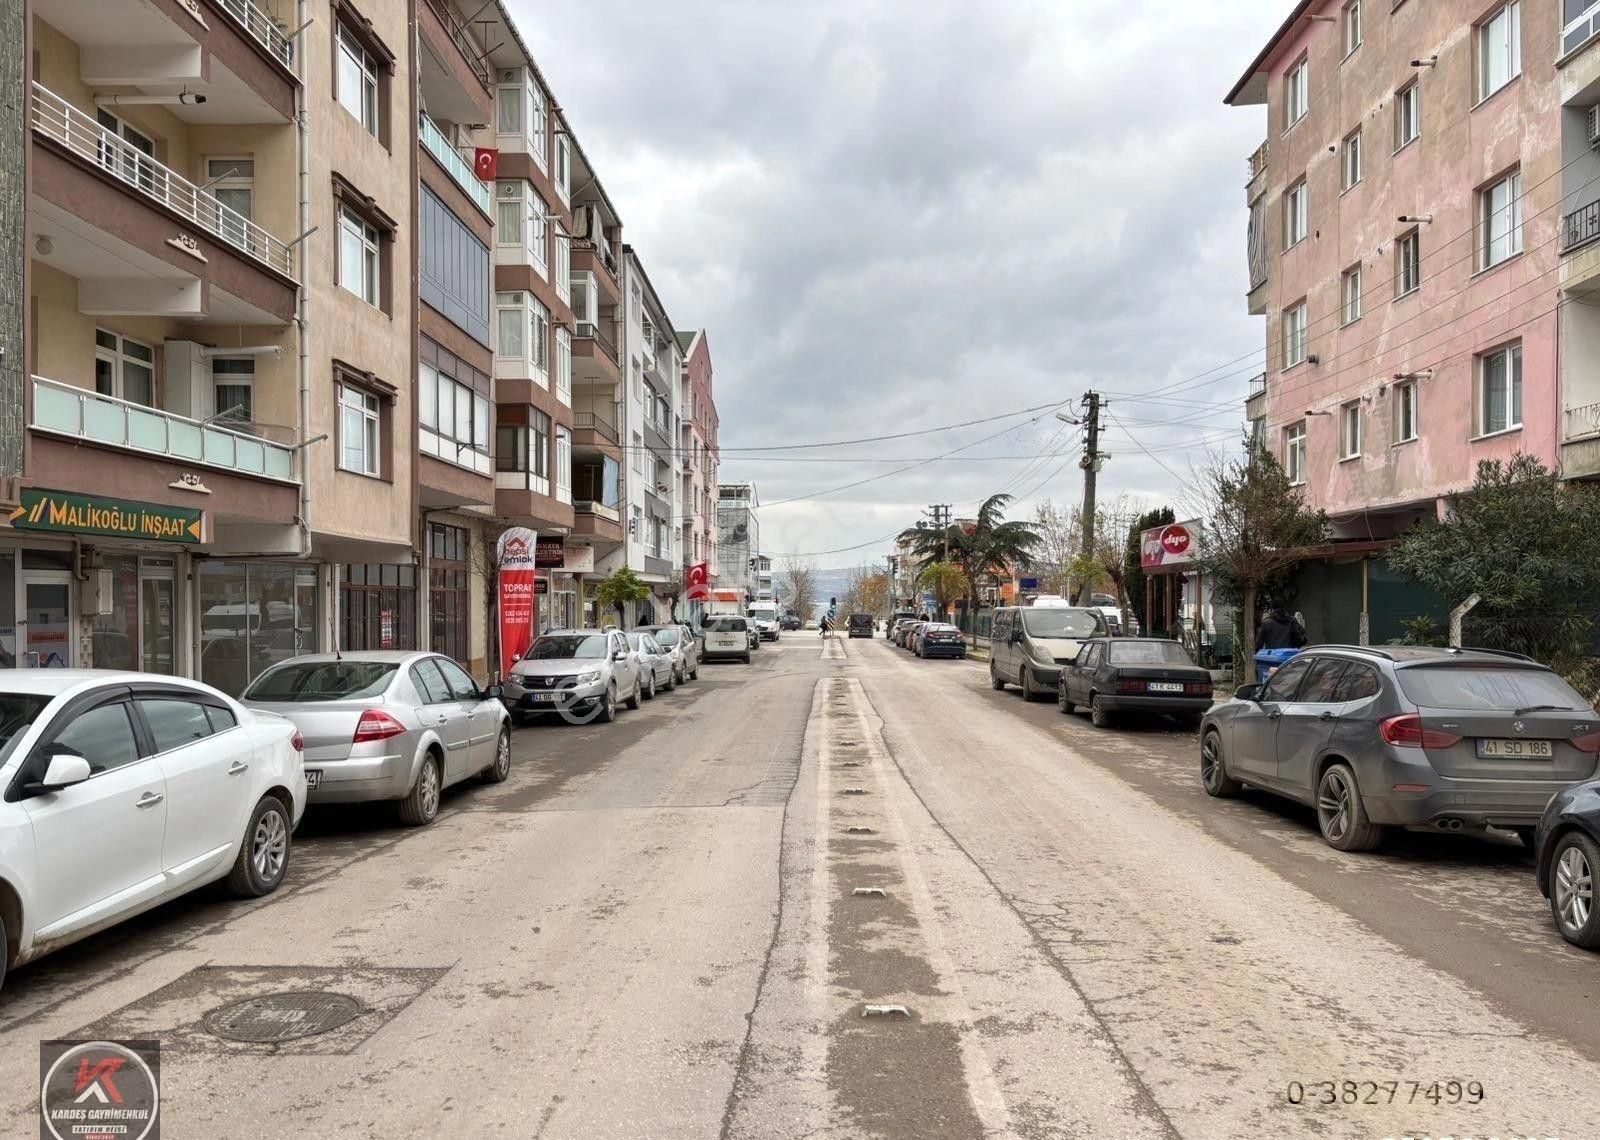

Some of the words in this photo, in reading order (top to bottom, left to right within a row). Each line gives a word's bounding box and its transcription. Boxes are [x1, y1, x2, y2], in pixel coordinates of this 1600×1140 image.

[49, 499, 137, 531] MALİKOĞLU
[141, 510, 186, 538] İNŞAAT
[1164, 534, 1187, 546] dyo
[1485, 741, 1497, 753] 41
[1504, 743, 1522, 754] SD
[1529, 743, 1548, 754] 186
